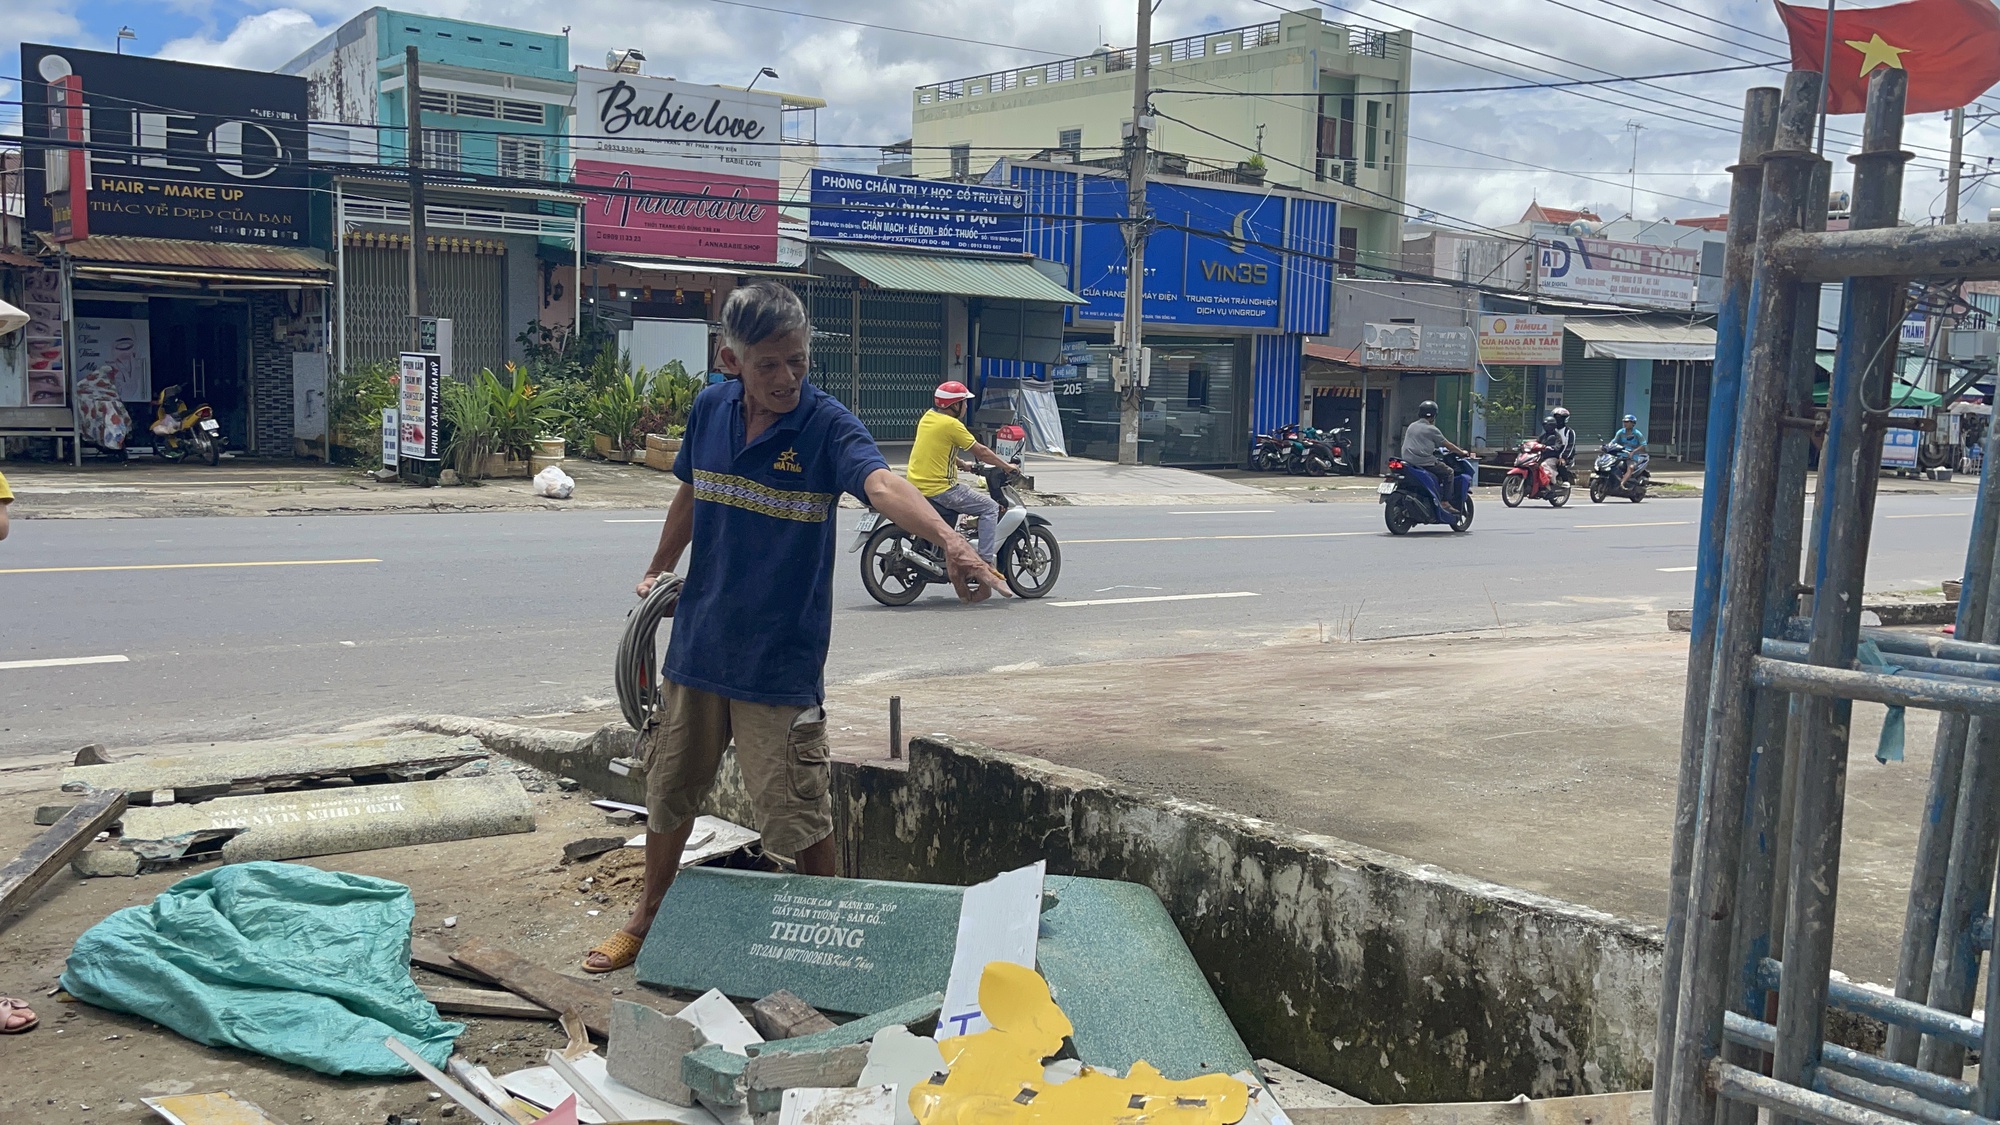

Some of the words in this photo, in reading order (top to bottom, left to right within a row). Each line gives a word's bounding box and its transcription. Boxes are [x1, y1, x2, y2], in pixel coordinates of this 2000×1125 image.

[101, 178, 144, 194] HAIR
[164, 184, 216, 200] MAKE
[221, 189, 244, 201] UP
[822, 174, 863, 190] PHÒNG
[931, 187, 953, 201] HỌC
[972, 189, 1012, 206] TRUYỀN
[884, 222, 904, 234] MẠCH
[1108, 264, 1157, 277] VINST
[1186, 294, 1213, 303] TRUNG
[1214, 294, 1230, 304] TÂM
[1196, 307, 1216, 316] DỊCH
[1217, 308, 1227, 316] VỤ
[1228, 308, 1266, 317] VINGROUP
[1514, 323, 1548, 331] RIMULA
[1522, 337, 1536, 346] AN
[1063, 383, 1082, 395] 205
[431, 429, 439, 455] PHUN
[769, 920, 865, 949] THƯỢNG
